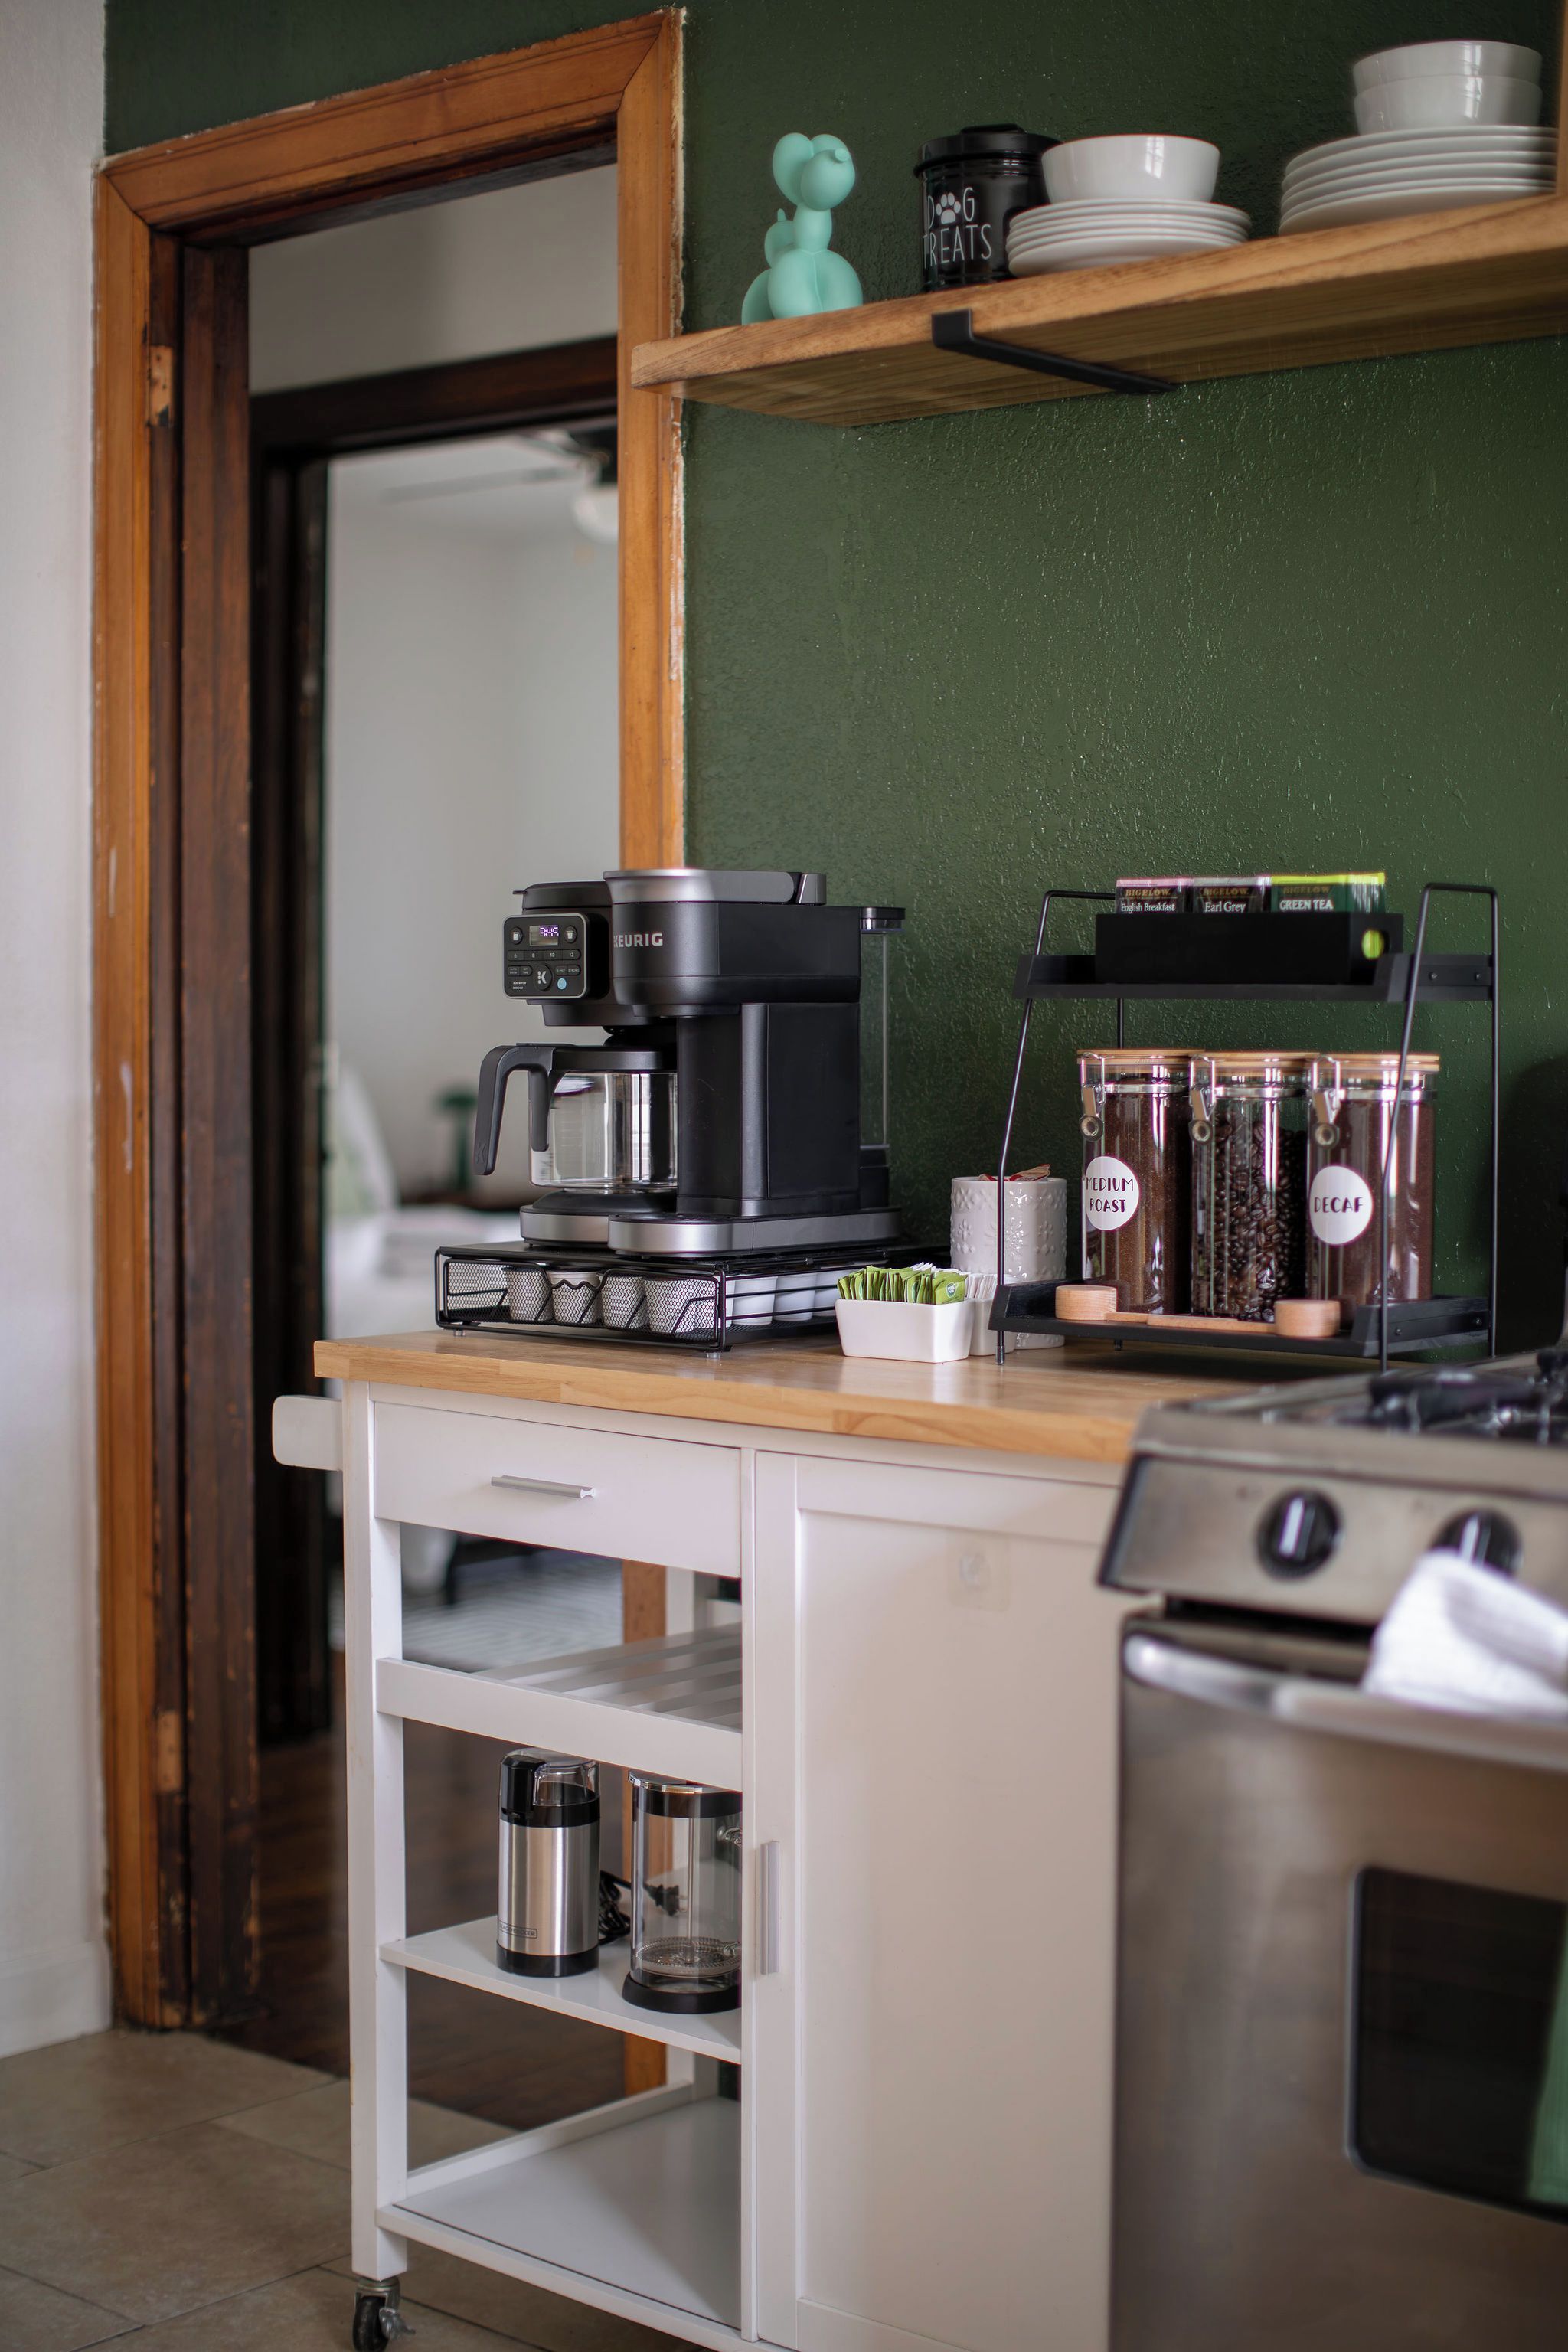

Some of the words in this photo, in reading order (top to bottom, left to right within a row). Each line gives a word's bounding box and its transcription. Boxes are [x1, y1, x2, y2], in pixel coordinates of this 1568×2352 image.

[927, 187, 975, 229] DG
[923, 224, 992, 269] TREATS
[1121, 902, 1142, 914] English
[1144, 901, 1175, 912] Breakfast
[1204, 901, 1223, 912] Earl
[1223, 901, 1246, 913] Grey
[1279, 900, 1312, 911] GREEN
[1312, 899, 1334, 910] TEA
[613, 933, 663, 948] KEURIG
[1086, 1177, 1134, 1192] MEDIUM
[1089, 1198, 1126, 1214] ROAST
[1314, 1196, 1364, 1214] DECAF
